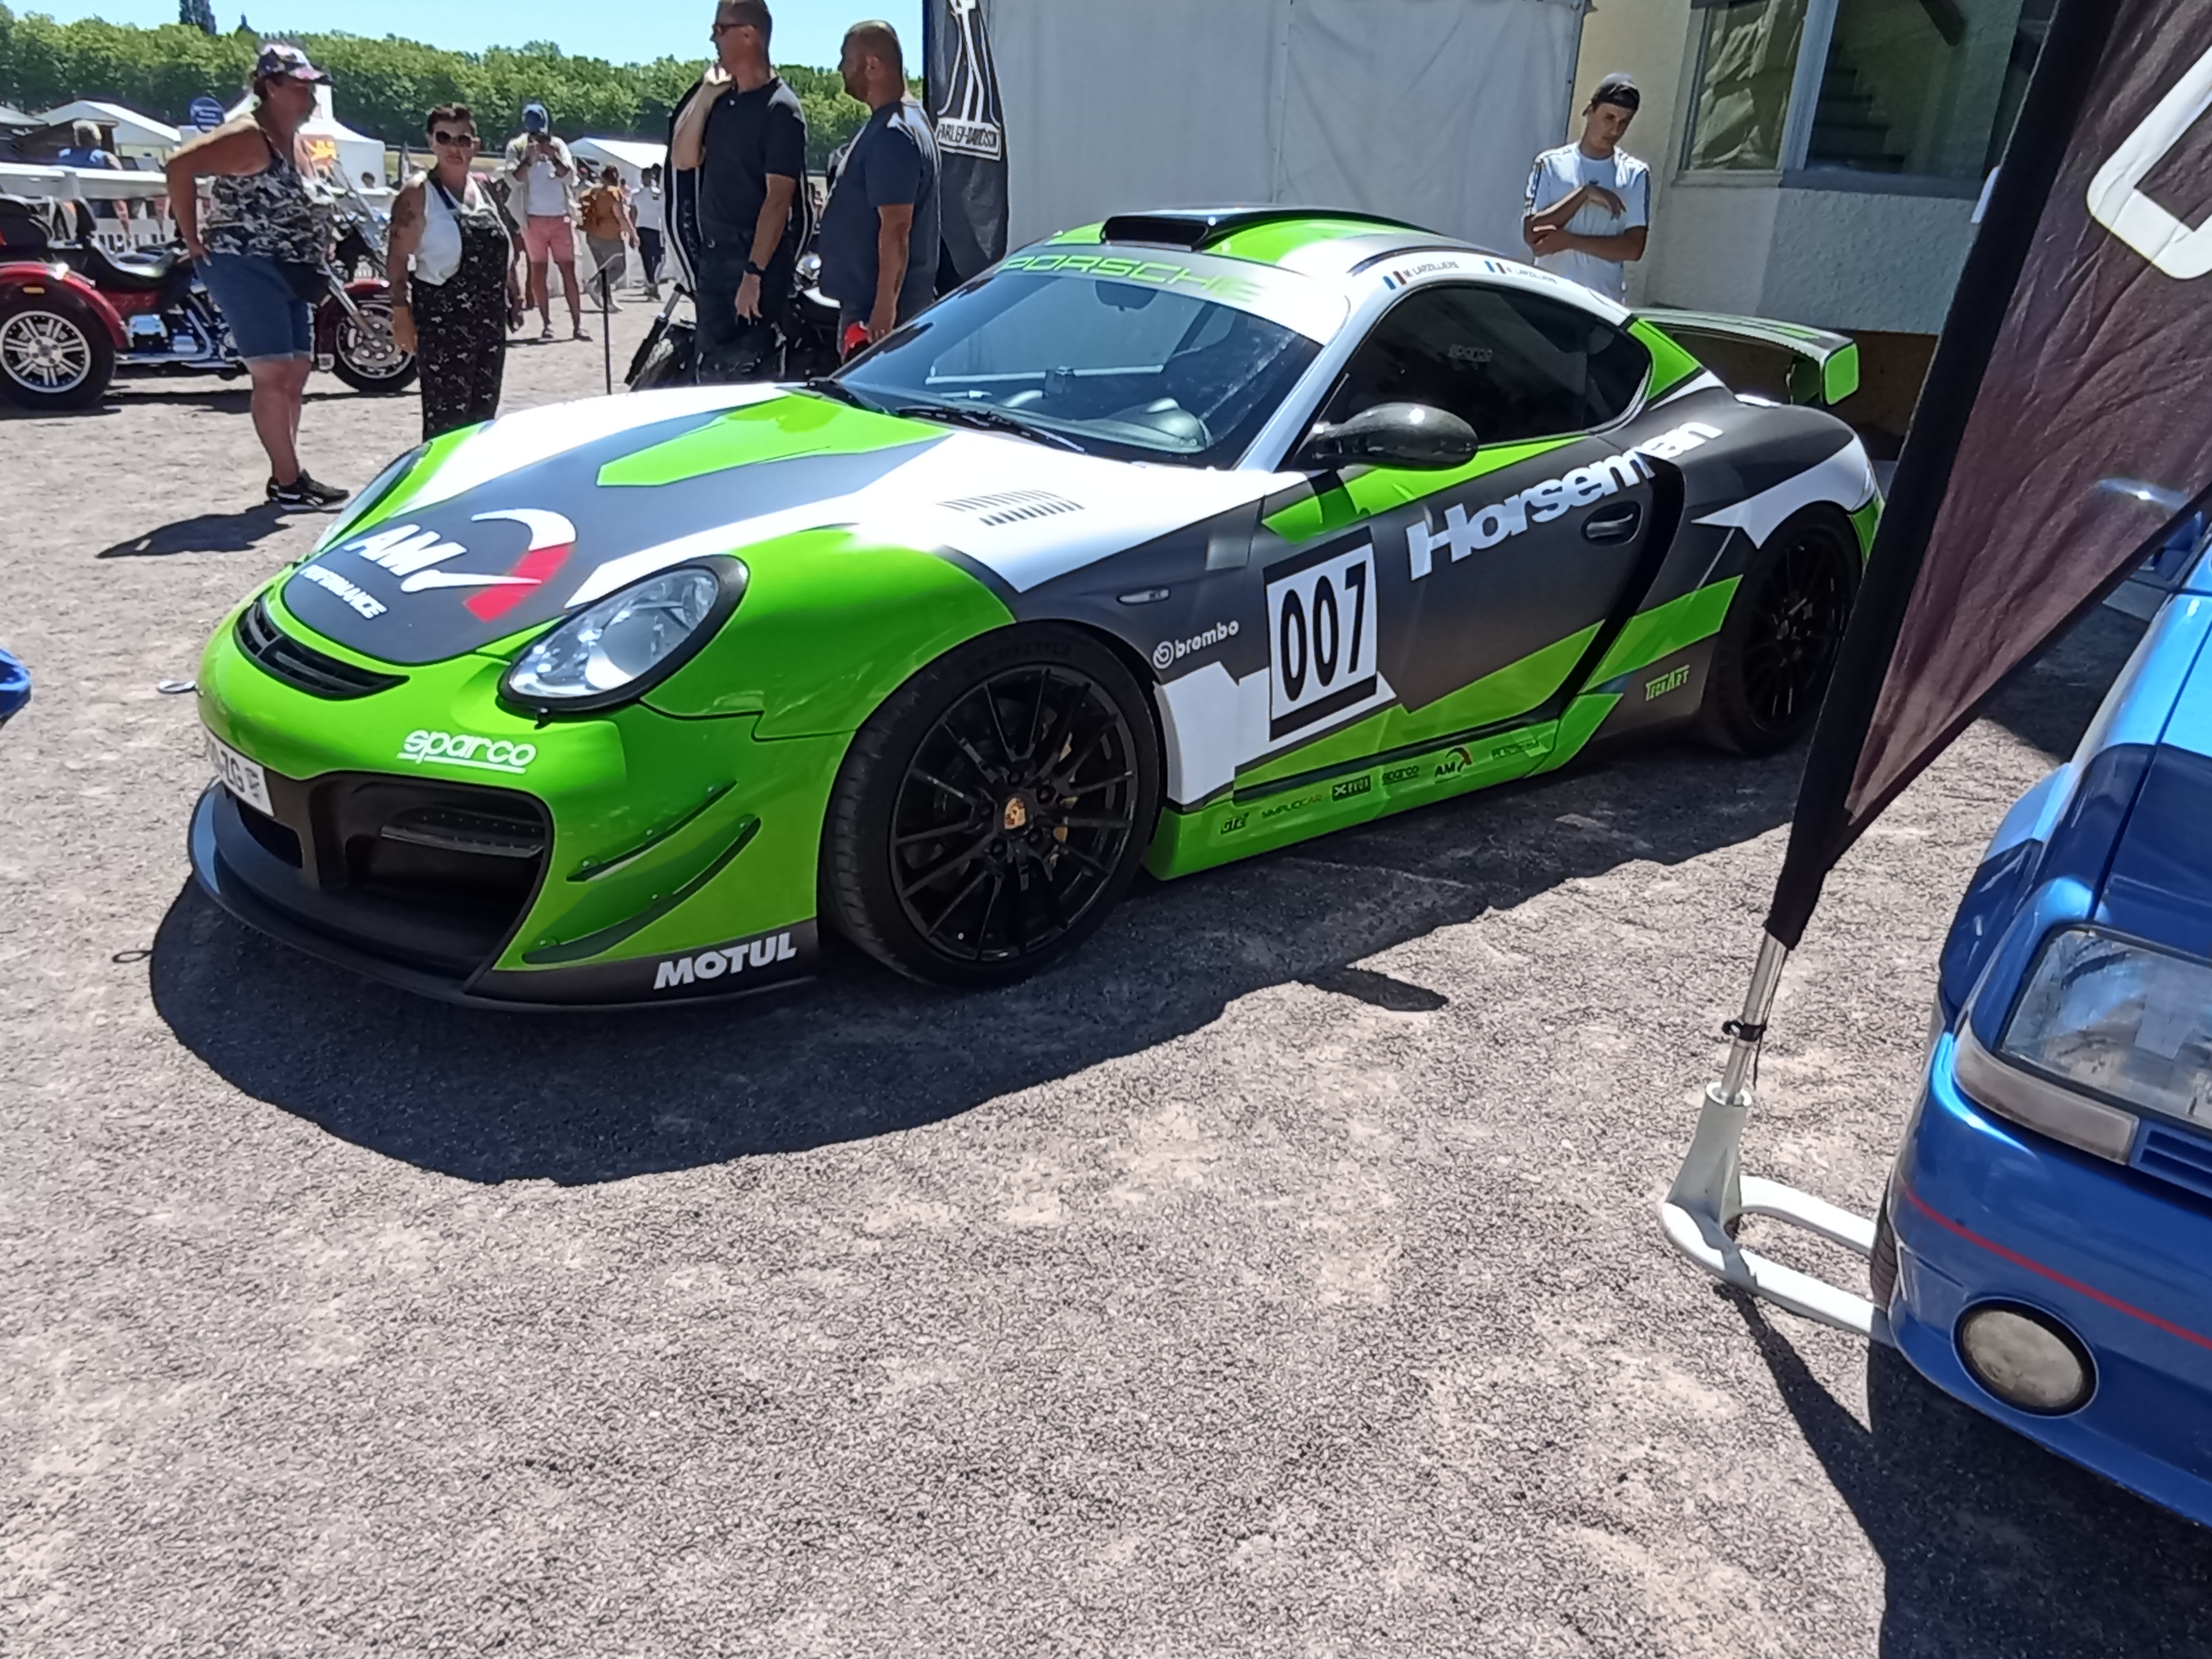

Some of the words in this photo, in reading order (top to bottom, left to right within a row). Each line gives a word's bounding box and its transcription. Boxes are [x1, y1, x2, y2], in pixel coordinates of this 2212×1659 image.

[993, 254, 1267, 303] PORSCHE
[1405, 422, 1725, 581] Horseman
[1174, 619, 1240, 659] brembo
[1279, 559, 1368, 702] 007
[403, 729, 537, 769] sparco
[653, 932, 797, 990] MOTUL
